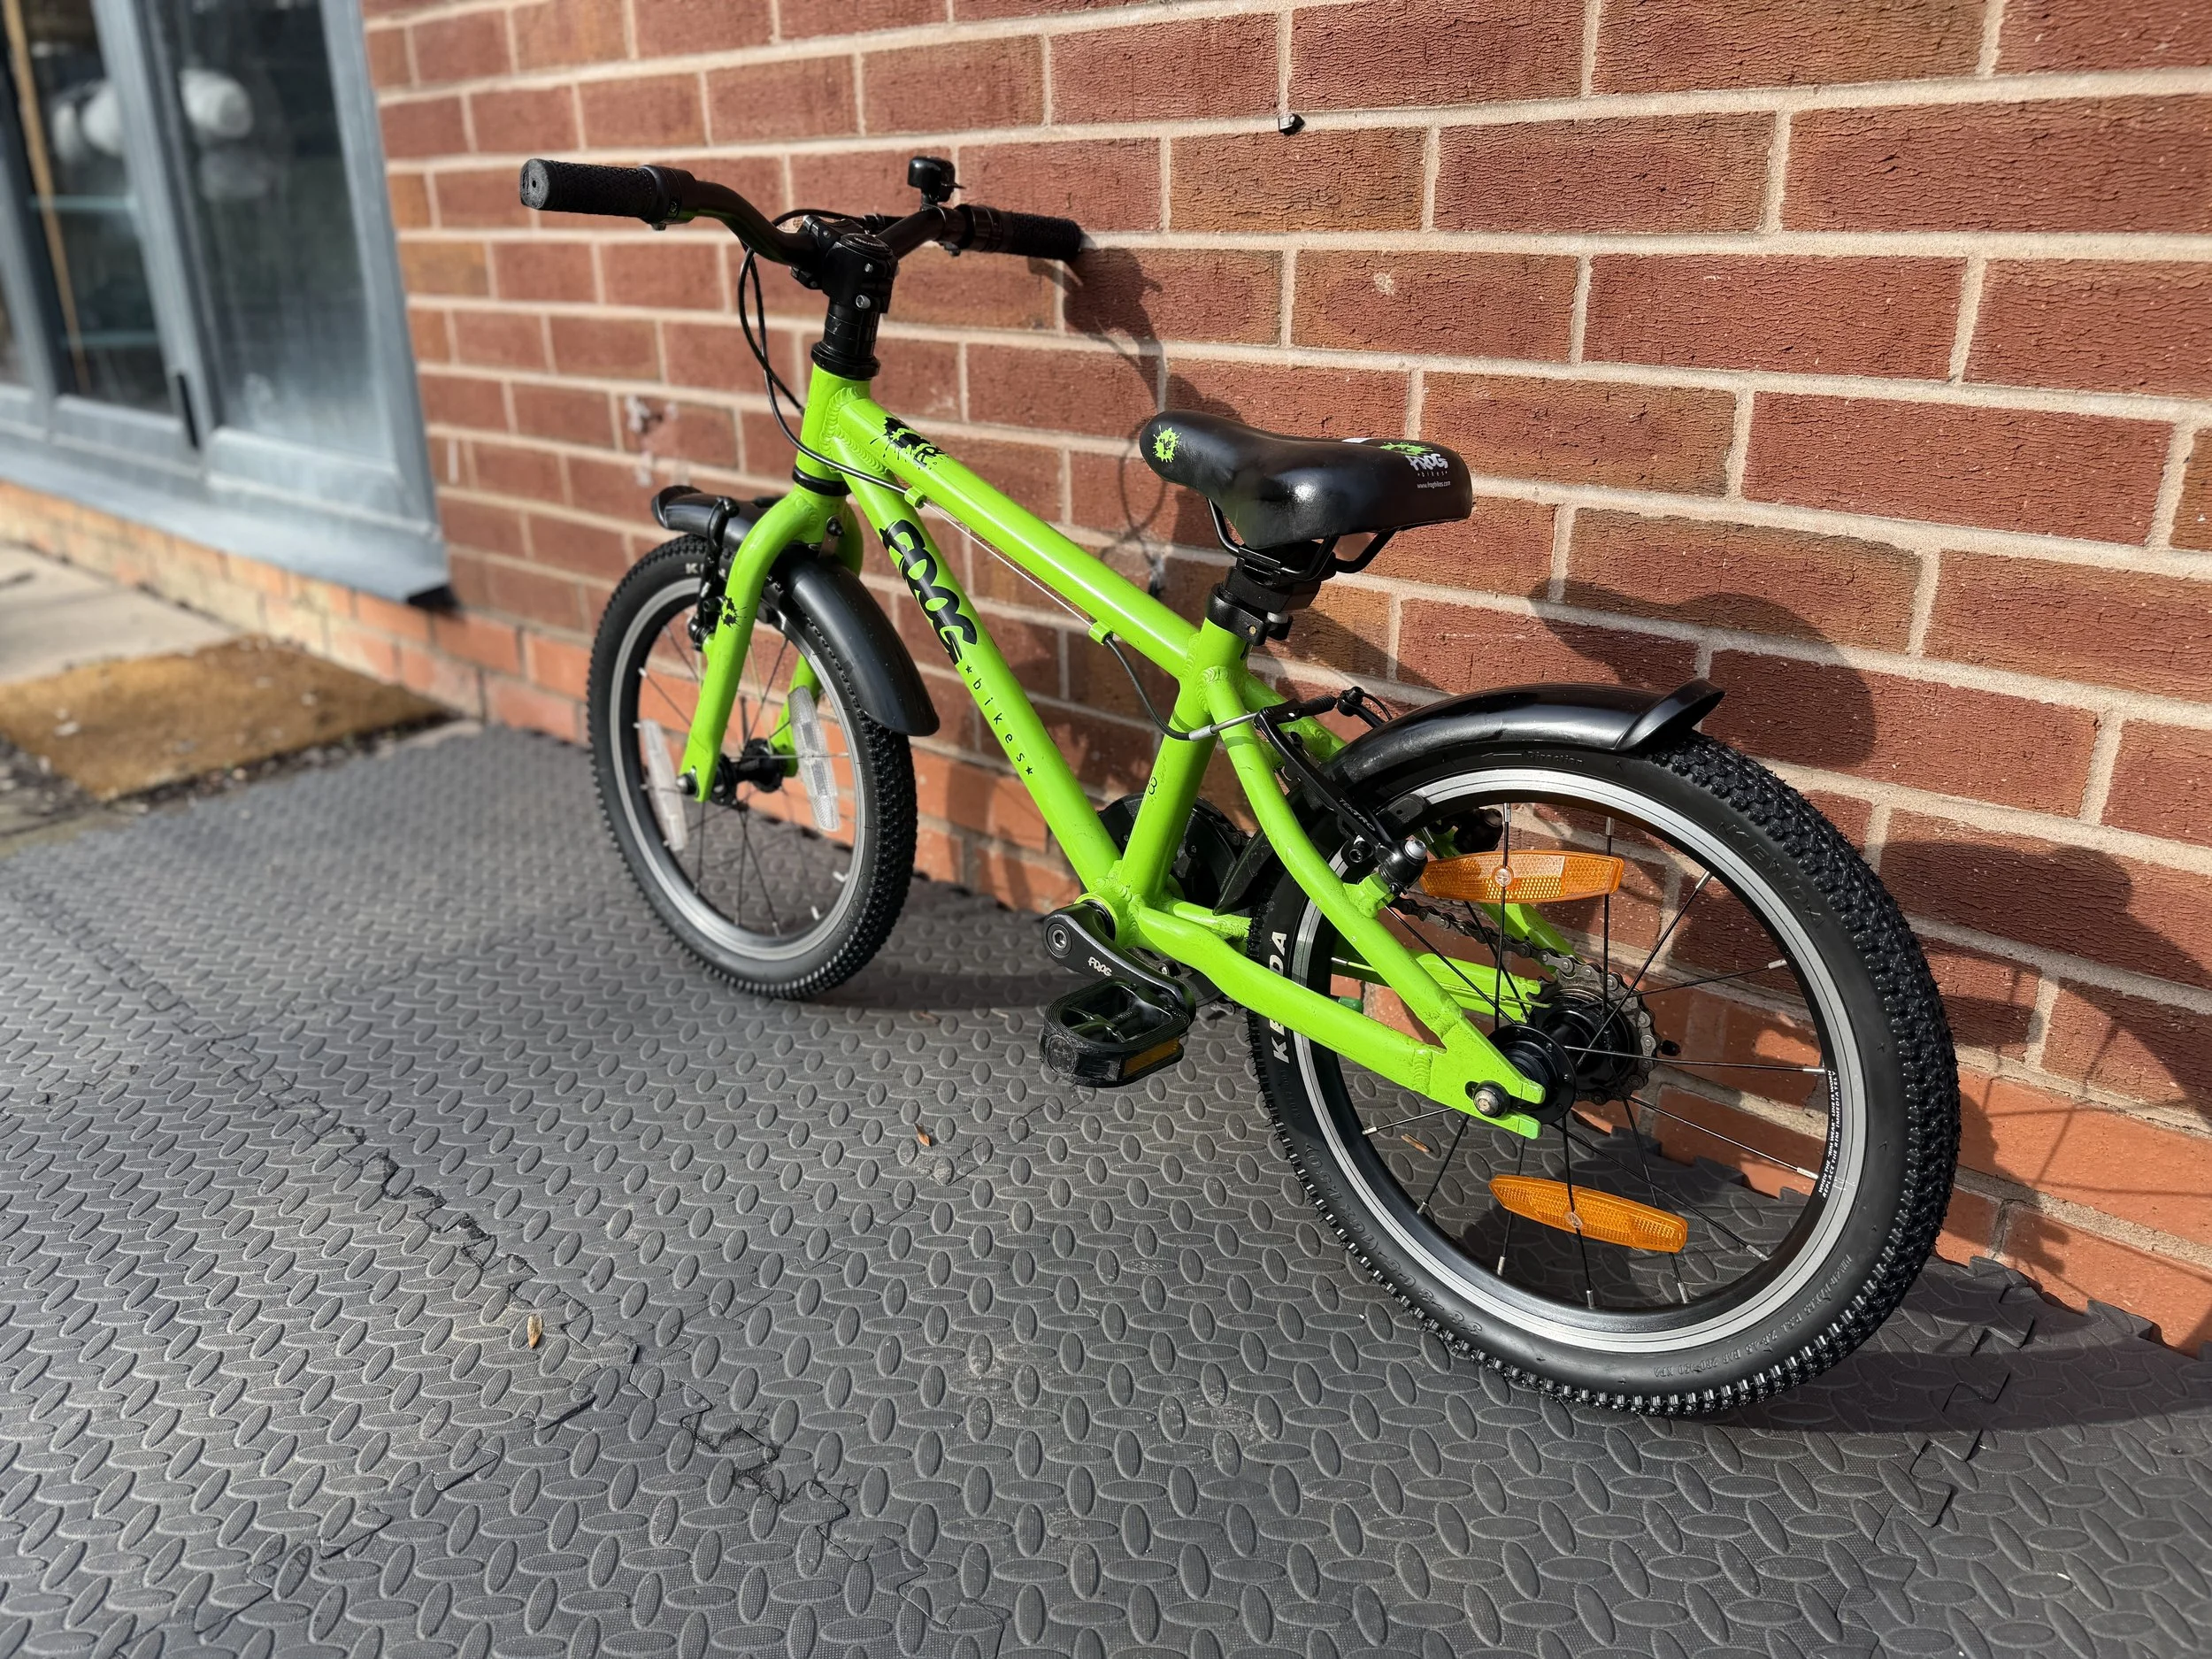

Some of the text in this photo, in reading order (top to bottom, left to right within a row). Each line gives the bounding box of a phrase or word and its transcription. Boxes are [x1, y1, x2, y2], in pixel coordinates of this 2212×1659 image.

[1405, 453, 1448, 471] FROG
[879, 518, 977, 665] FROG
[972, 676, 1026, 763] bikes
[1338, 797, 1377, 832] TEKTRO
[1087, 956, 1112, 977] FROG
[1269, 931, 1289, 1064] KEDA
[1822, 1164, 1835, 1199] REPLACE
[1832, 1071, 1840, 1128] IMMEDIATELY
[1818, 1172, 1828, 1194] WHEN
